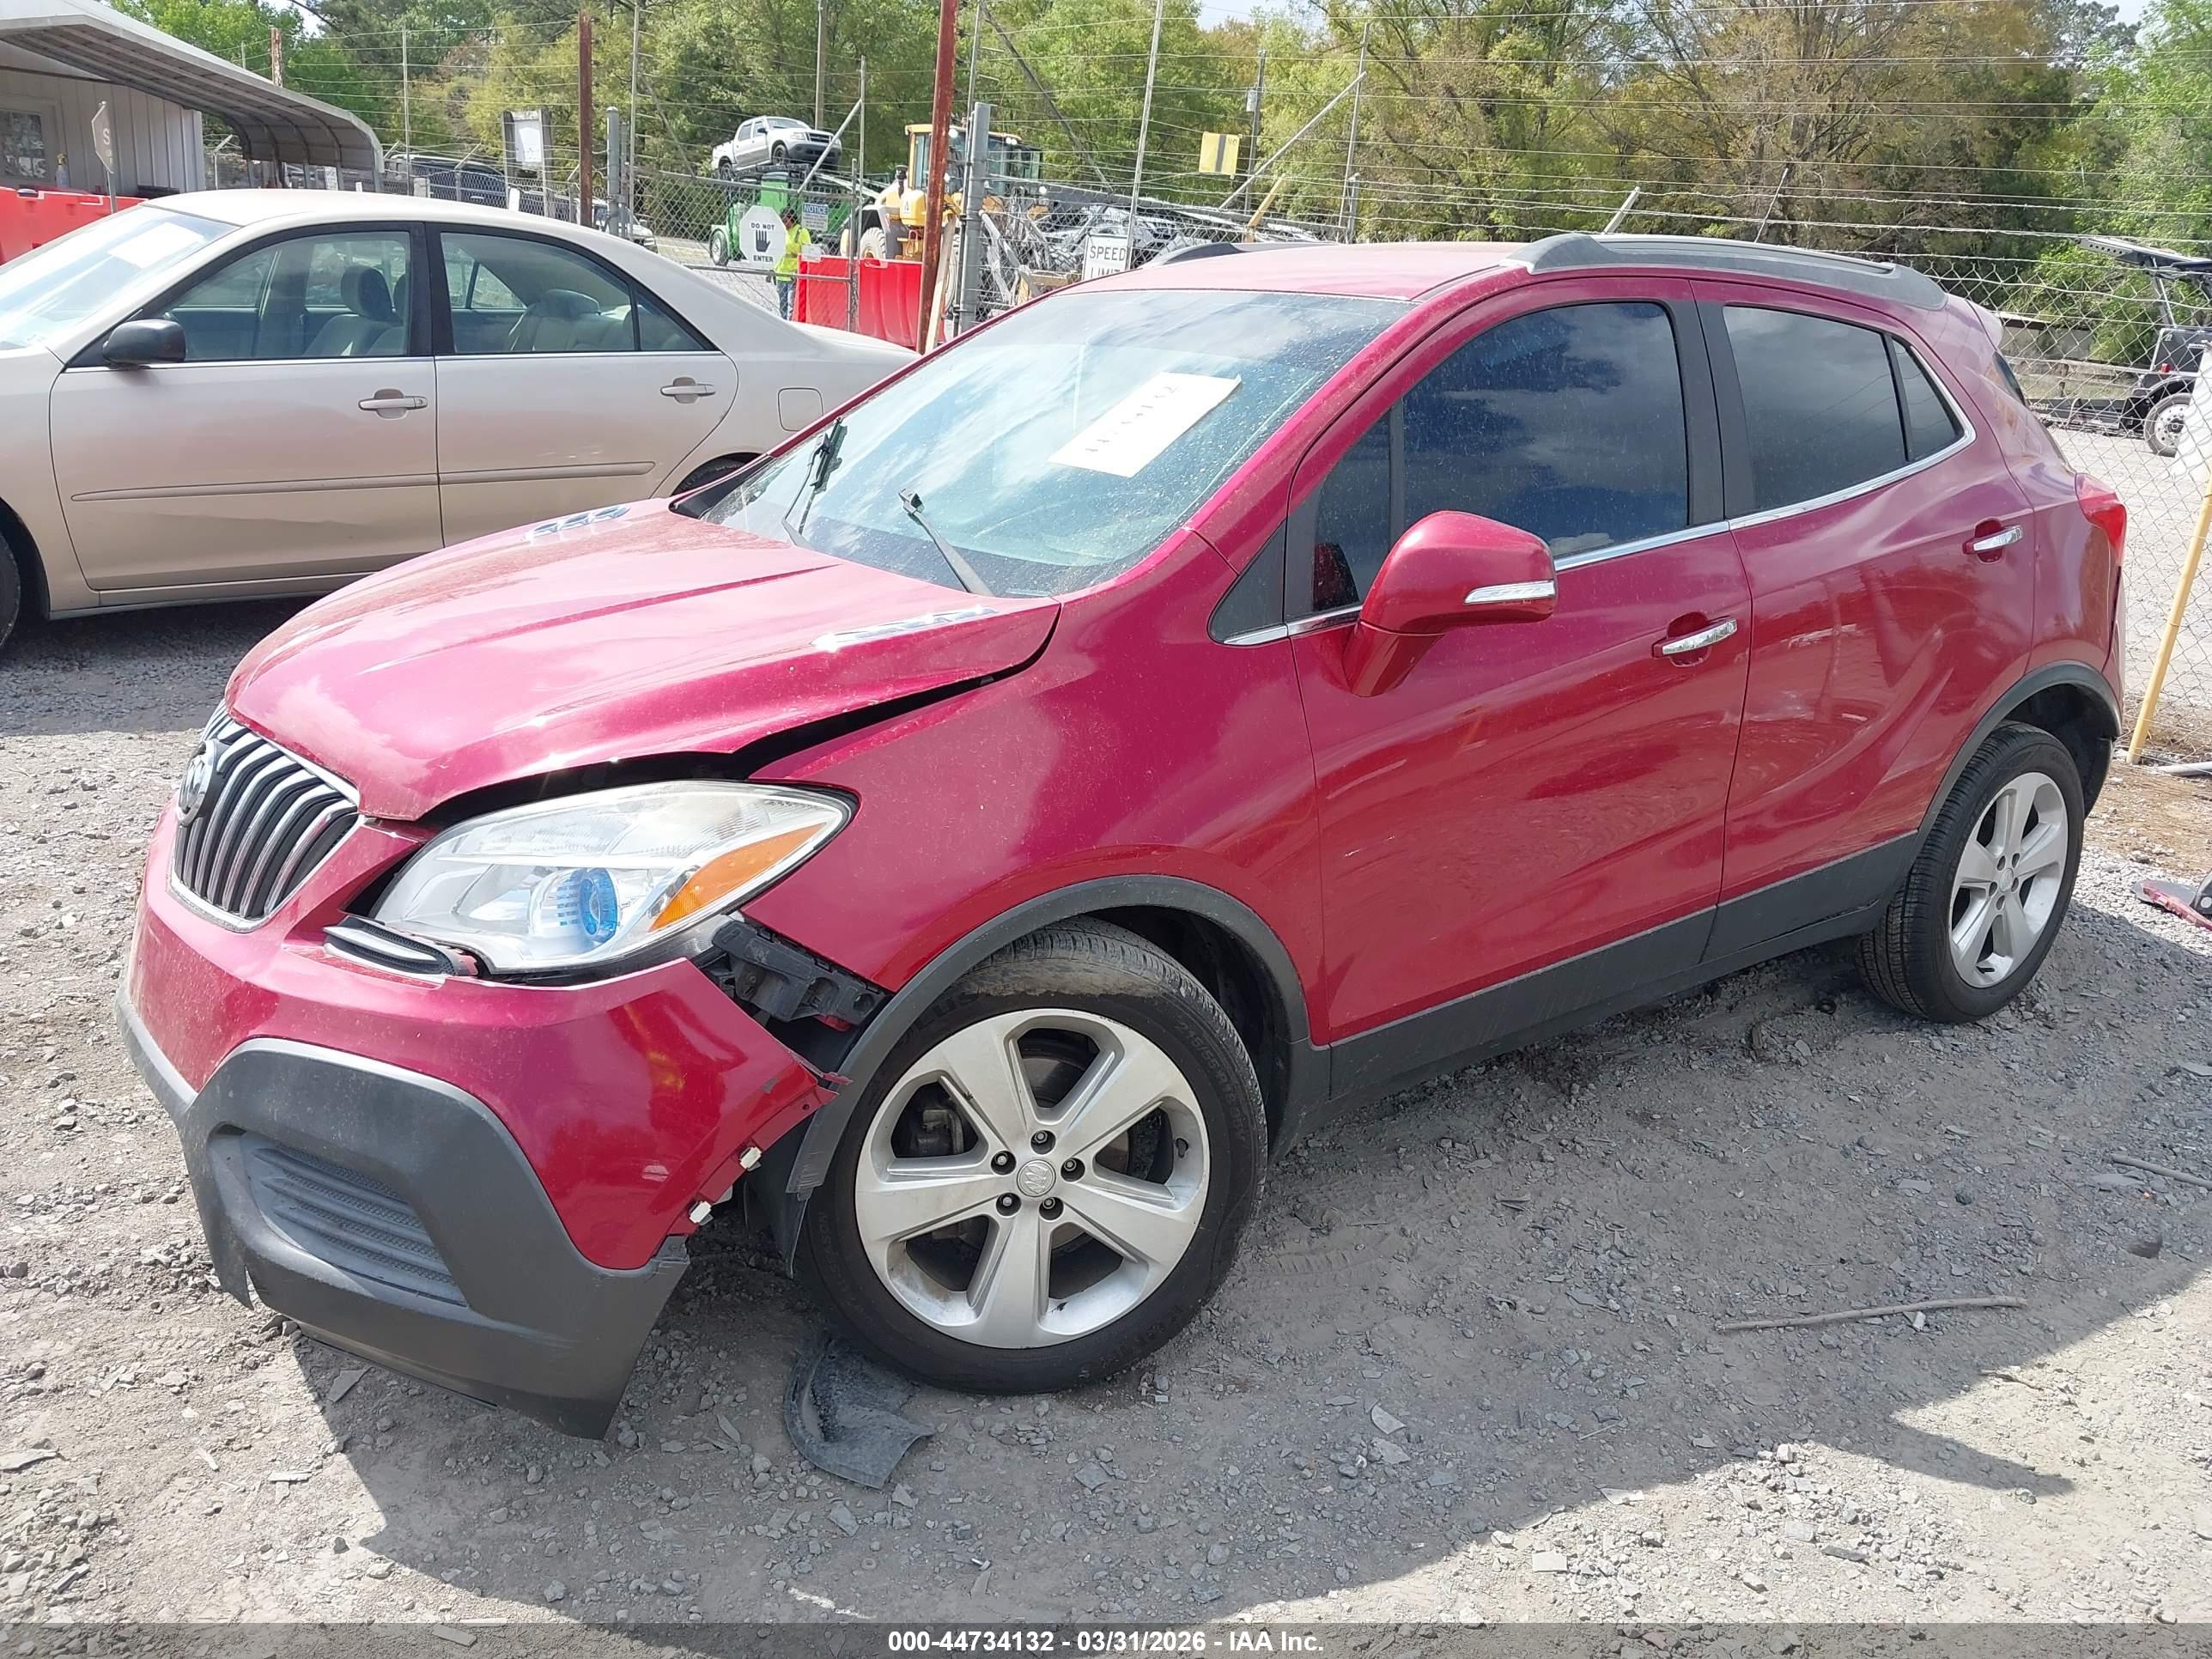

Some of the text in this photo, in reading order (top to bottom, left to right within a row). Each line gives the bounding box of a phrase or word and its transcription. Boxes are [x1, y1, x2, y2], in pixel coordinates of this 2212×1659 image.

[804, 204, 828, 215] NOTICE
[753, 254, 774, 263] ENTER
[1089, 246, 1127, 261] SPEED
